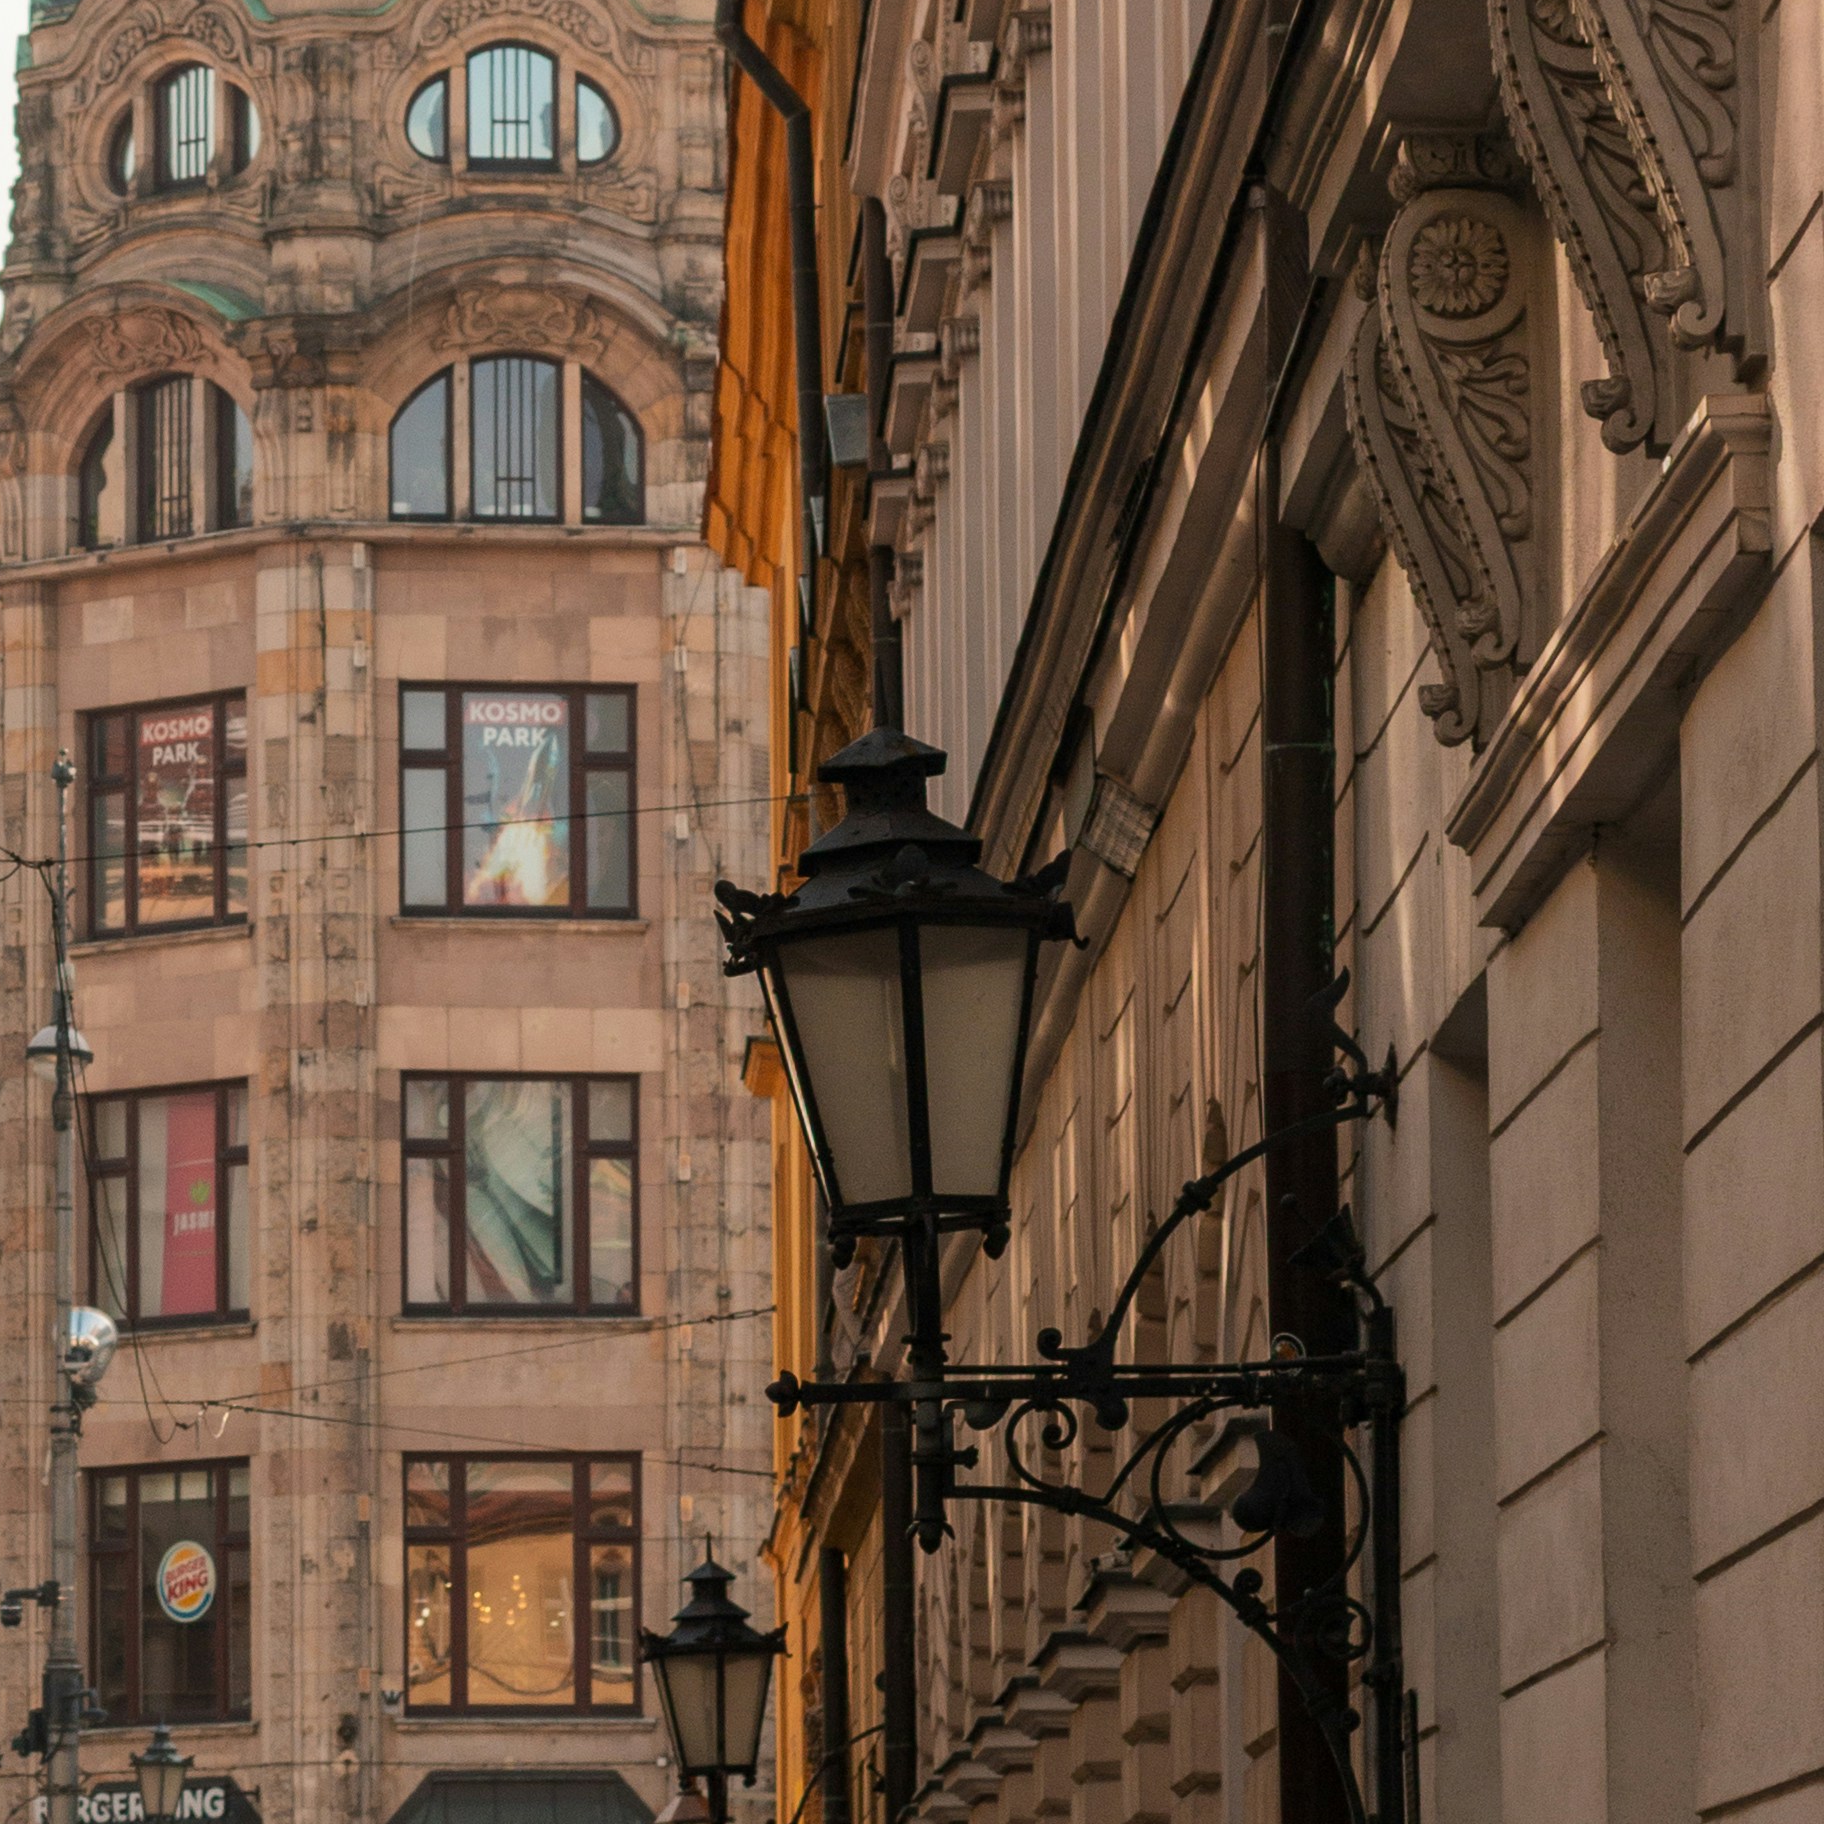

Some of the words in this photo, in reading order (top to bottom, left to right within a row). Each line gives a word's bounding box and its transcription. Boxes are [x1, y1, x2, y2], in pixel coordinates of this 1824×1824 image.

[469, 702, 562, 723] KOSMO
[142, 715, 210, 743] KOSMO
[483, 727, 548, 747] PARK
[152, 741, 200, 766] PARK
[167, 1570, 209, 1604] KING
[33, 1791, 145, 1824] BRGER
